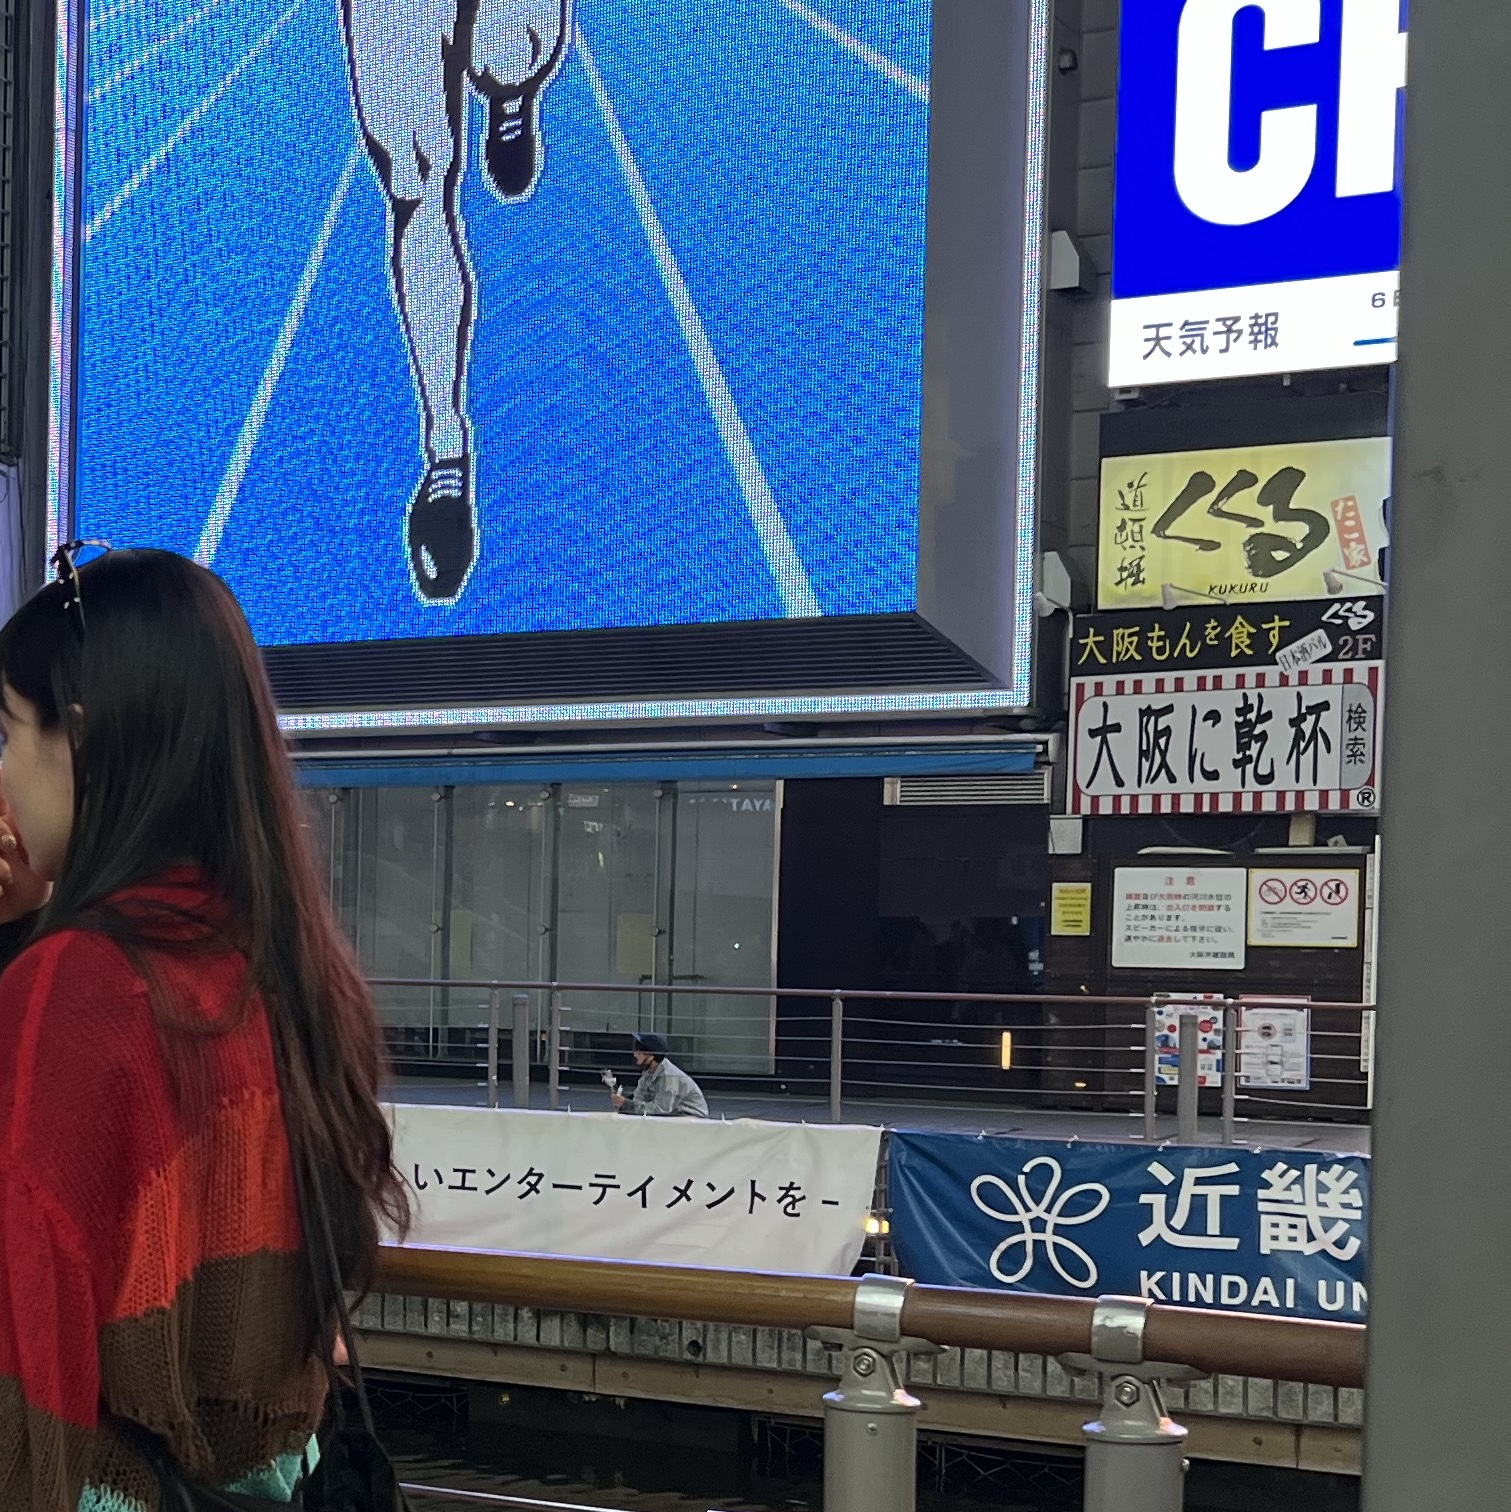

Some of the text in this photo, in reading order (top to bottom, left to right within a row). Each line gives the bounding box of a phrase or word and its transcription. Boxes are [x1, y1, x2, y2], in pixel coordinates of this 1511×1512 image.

[1142, 311, 1279, 361] 天気予報
[1114, 471, 1149, 591] 道頓堀
[1150, 466, 1331, 578] くくる
[1334, 500, 1369, 568] たこ家
[1208, 581, 1270, 596] KUKURU
[1077, 614, 1292, 666] 大阪もんを食す
[1338, 633, 1376, 661] 2F
[1085, 691, 1332, 789] 大阪に乾杯
[1345, 703, 1369, 766] 検索
[1138, 1161, 1364, 1262] 近畿
[1139, 1269, 1296, 1308] KINDAI
